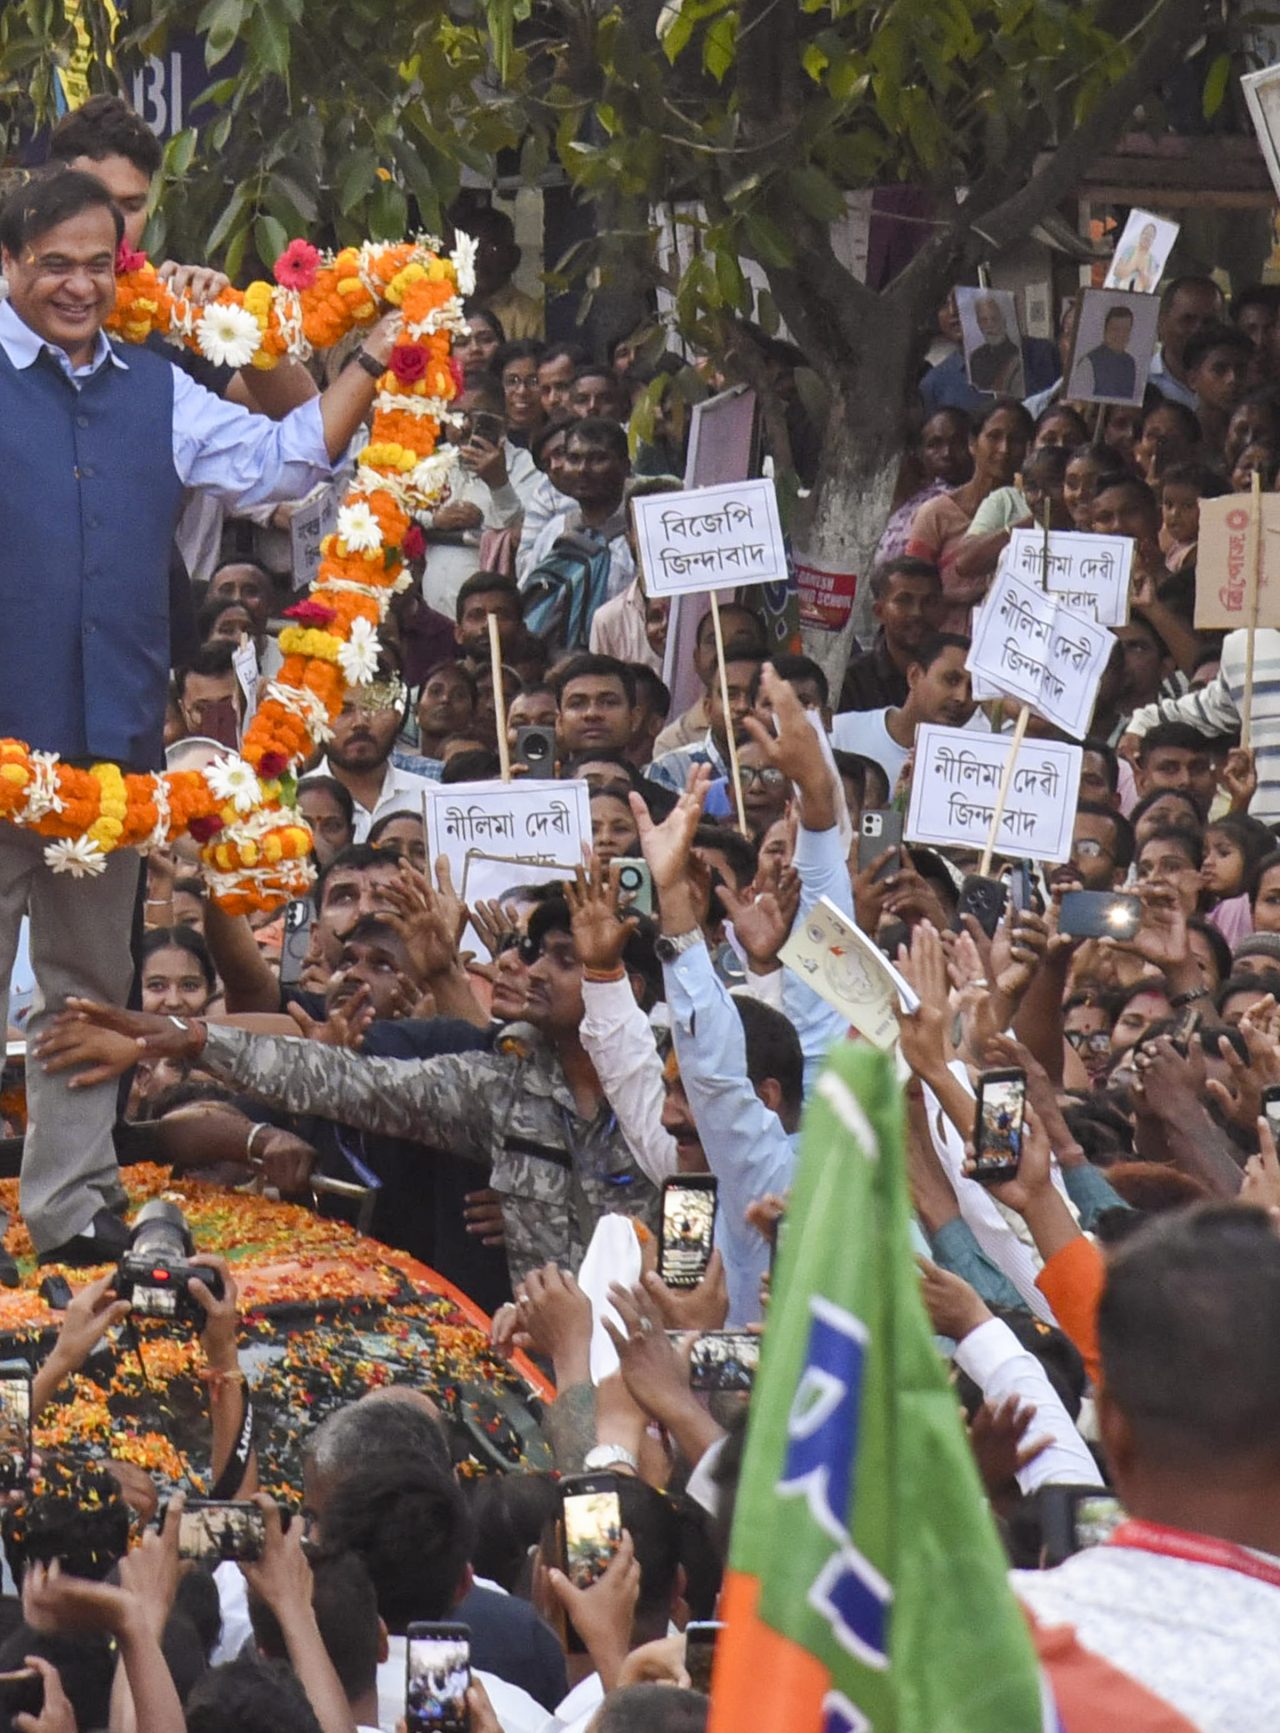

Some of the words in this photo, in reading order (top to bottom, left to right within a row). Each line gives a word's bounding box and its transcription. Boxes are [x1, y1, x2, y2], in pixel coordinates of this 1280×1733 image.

[659, 501, 754, 541] বিজেপি
[658, 543, 766, 578] জিন্দাবাদ
[934, 746, 1005, 791] নীলিমা
[444, 805, 515, 842] নীলিমা
[947, 791, 1038, 837] জিন্দবাদ
